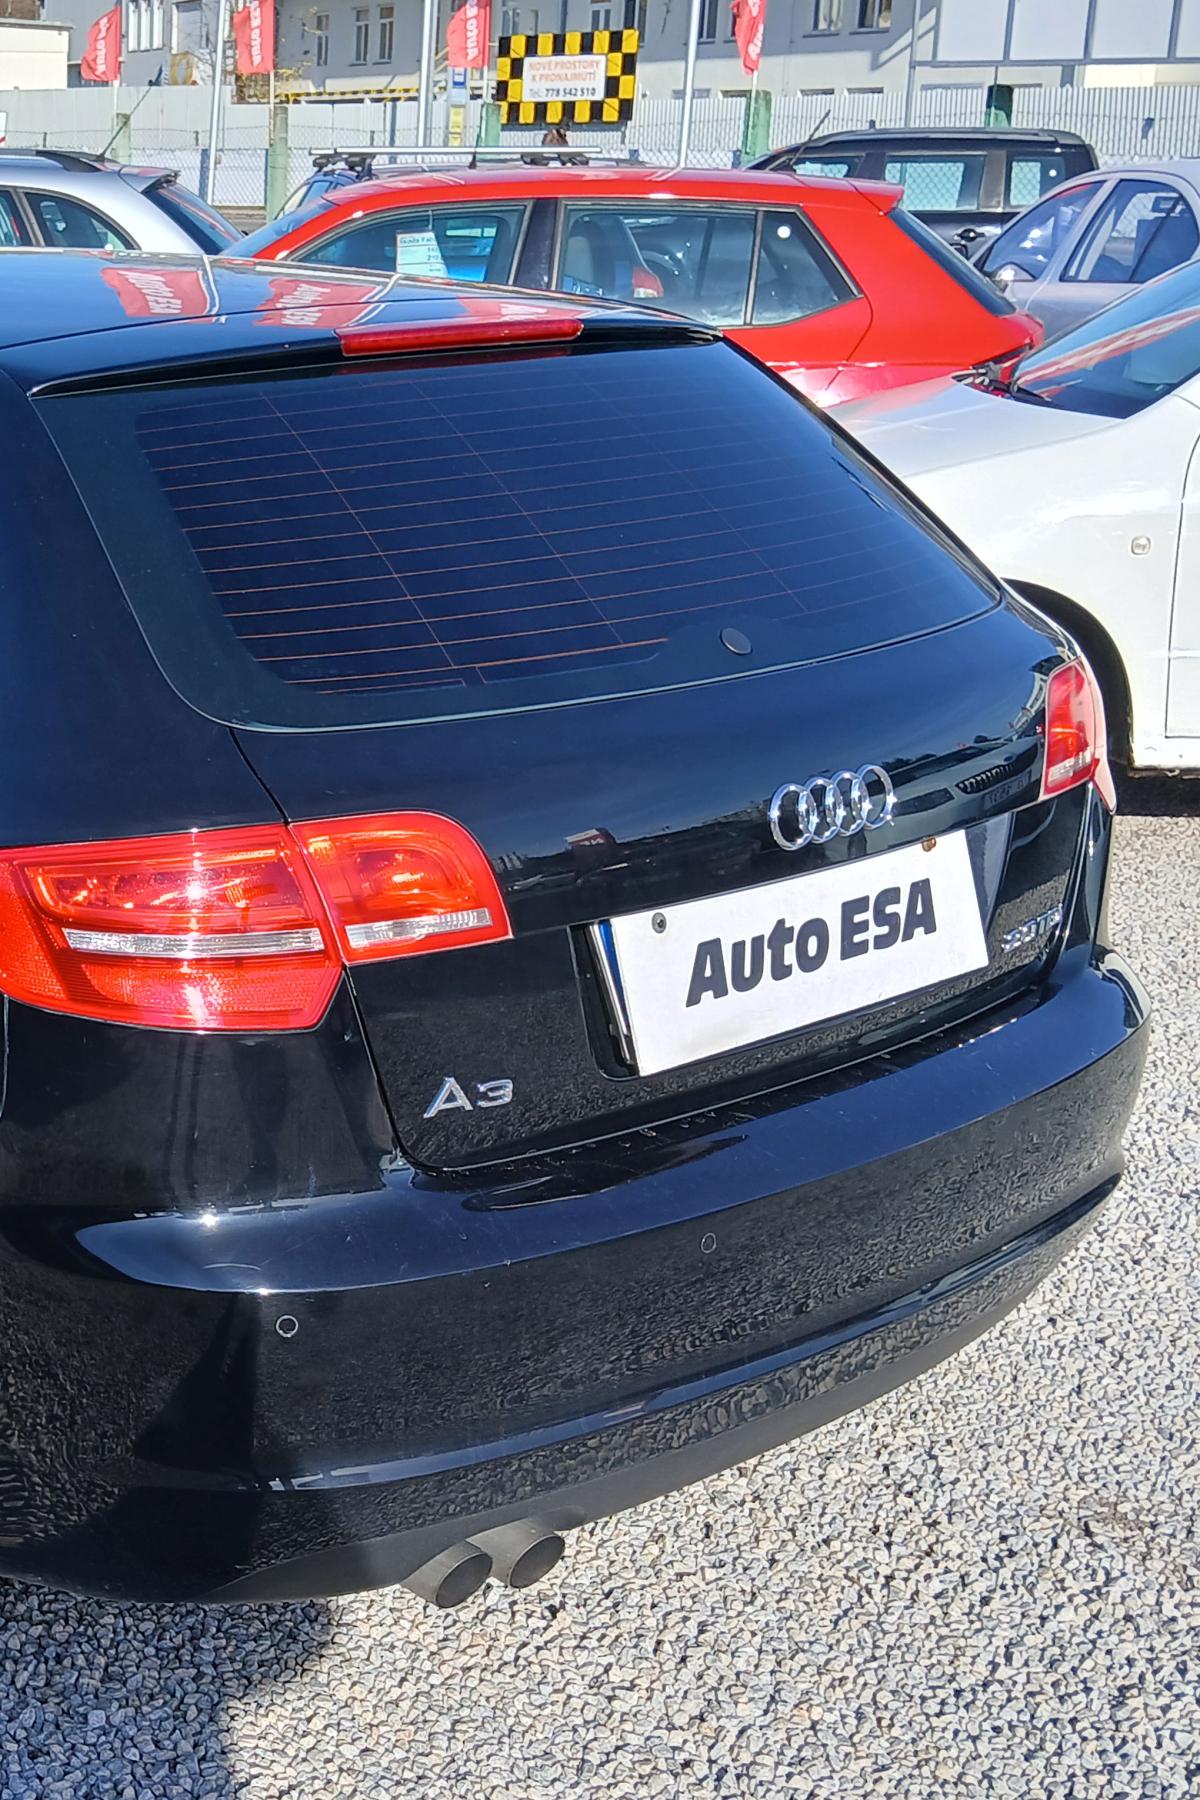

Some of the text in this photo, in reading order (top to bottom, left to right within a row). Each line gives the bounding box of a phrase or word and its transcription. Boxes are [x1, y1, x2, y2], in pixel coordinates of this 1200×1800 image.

[545, 88, 560, 98] 778
[562, 88, 578, 97] 542
[580, 87, 596, 97] 510
[686, 878, 937, 1008] Auto ESA
[423, 1077, 513, 1118] A3
